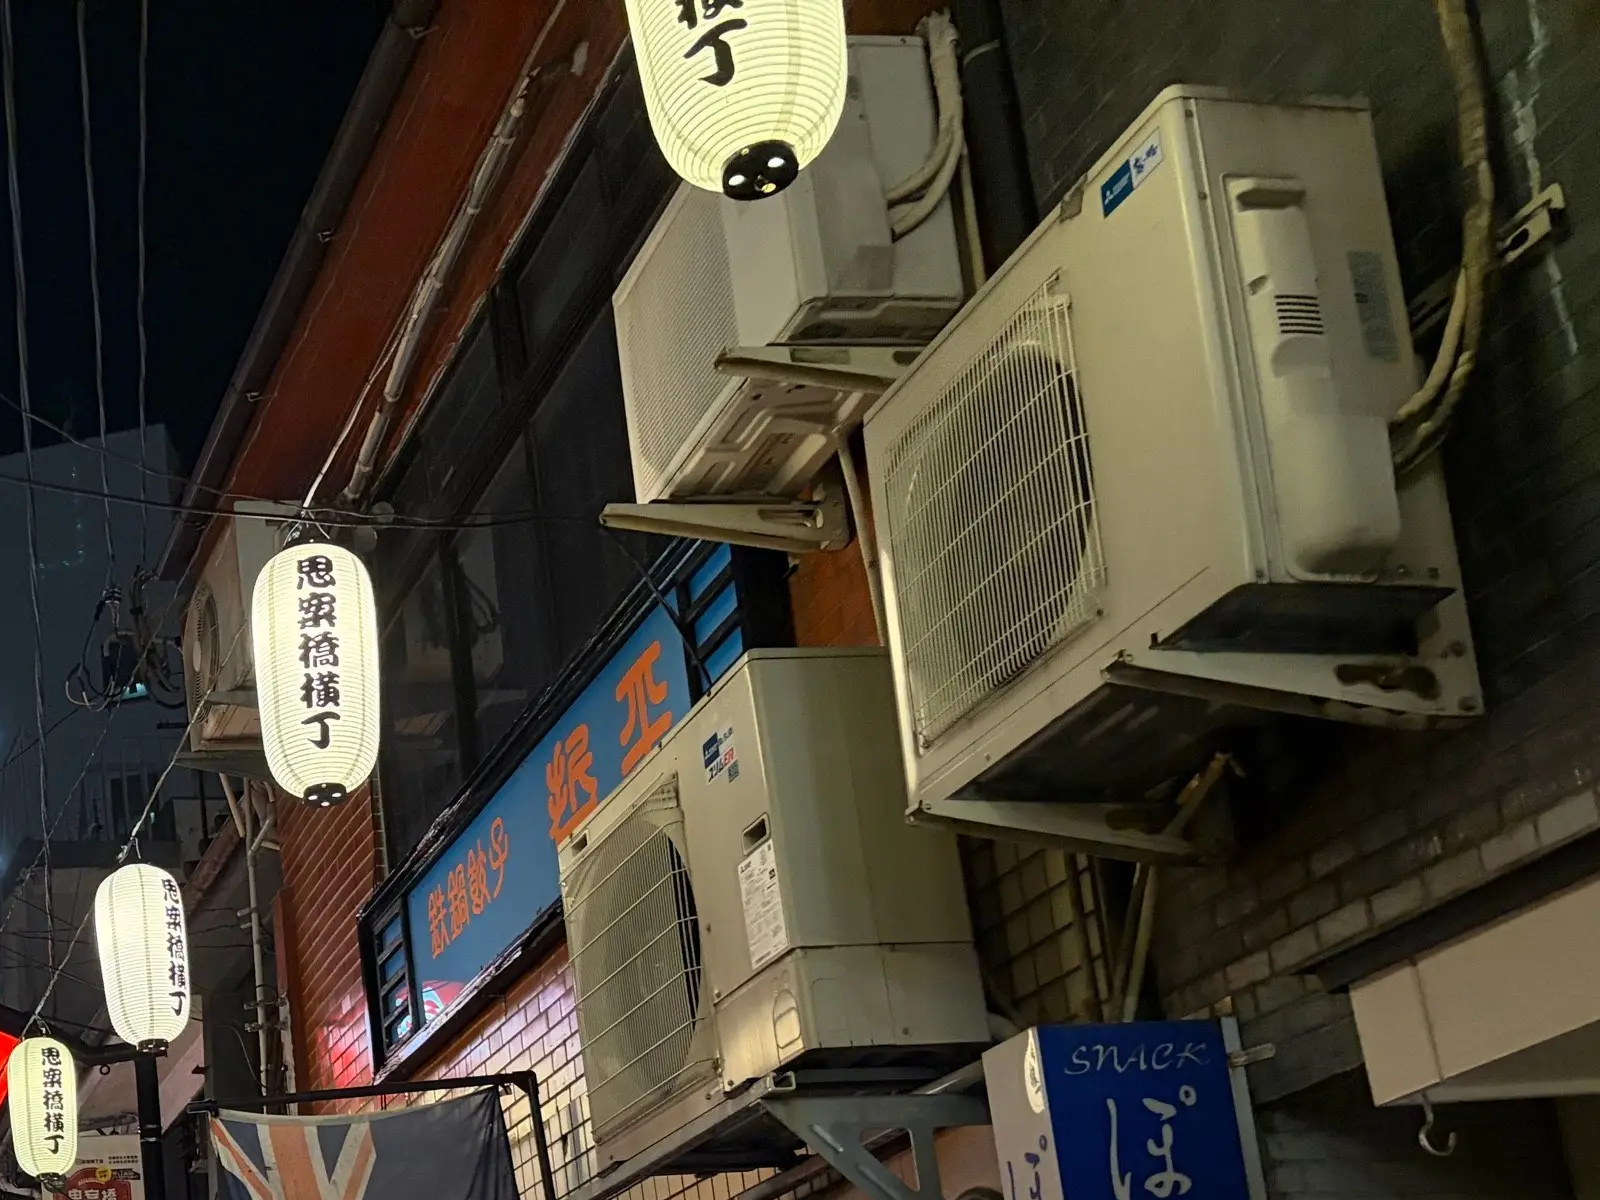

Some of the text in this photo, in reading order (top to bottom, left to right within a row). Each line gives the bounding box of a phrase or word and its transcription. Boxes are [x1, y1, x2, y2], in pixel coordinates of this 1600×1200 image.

[296, 553, 342, 751] 思案橋横丁
[161, 876, 187, 1018] 思案橋横丁
[40, 1044, 67, 1158] 思案橋横丁
[1064, 1040, 1213, 1076] SNACK
